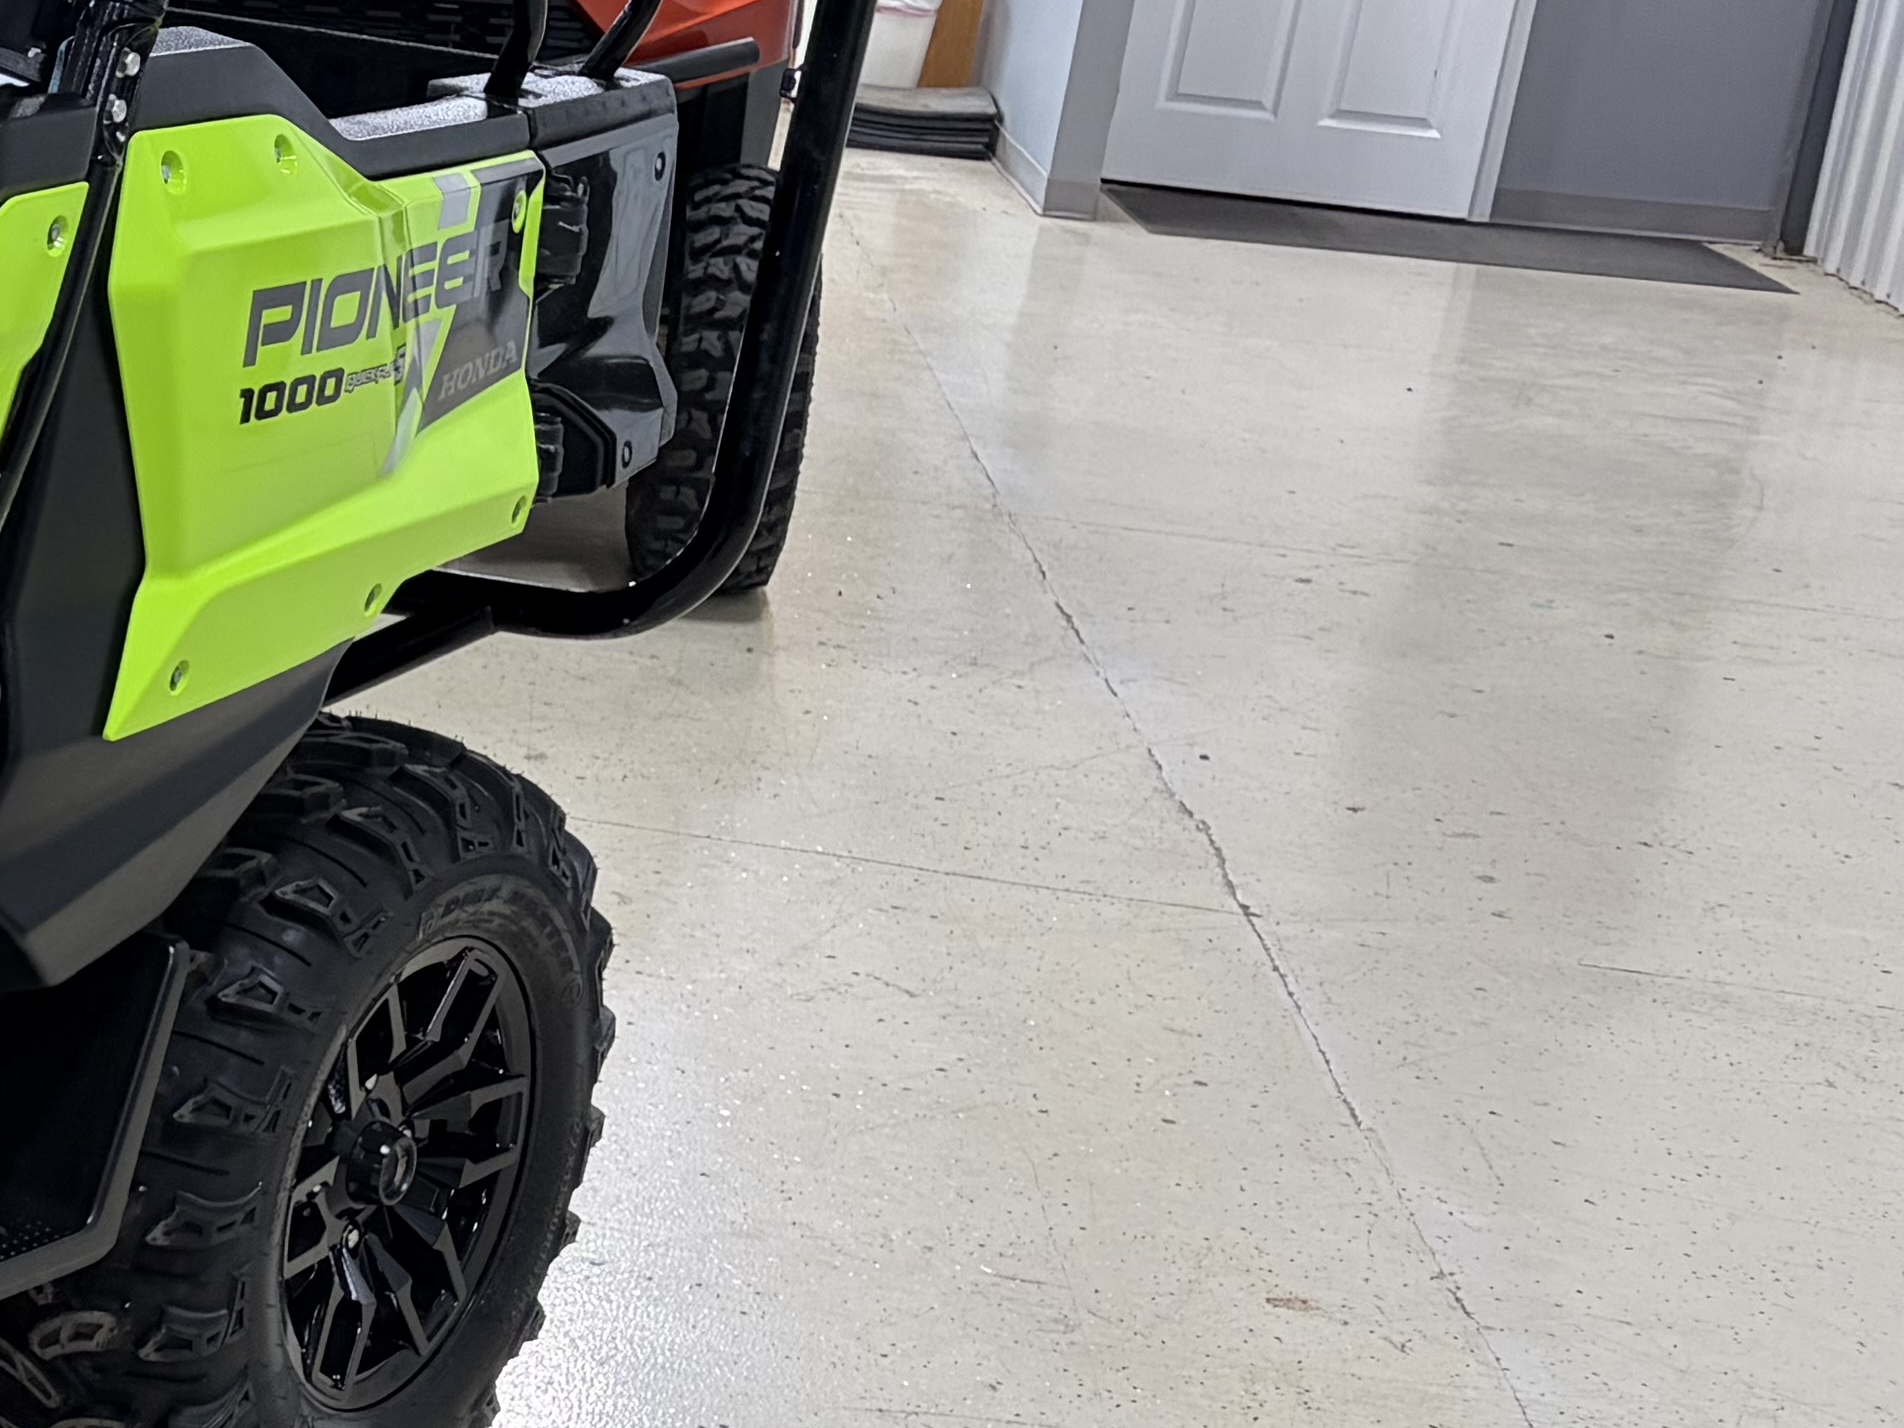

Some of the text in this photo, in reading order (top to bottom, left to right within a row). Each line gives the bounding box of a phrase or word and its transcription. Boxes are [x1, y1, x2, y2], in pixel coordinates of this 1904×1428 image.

[242, 218, 509, 368] PIONEER
[239, 368, 345, 425] 1000
[438, 340, 519, 400] HONDA
